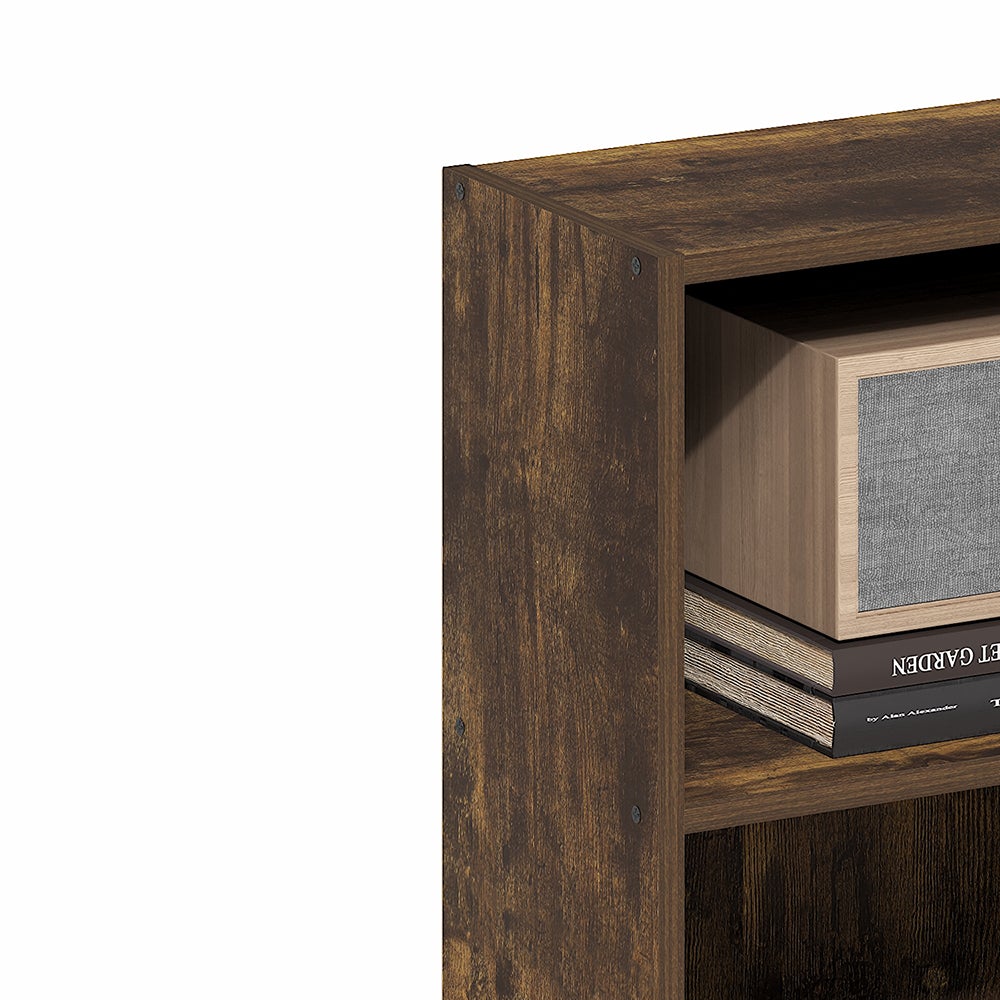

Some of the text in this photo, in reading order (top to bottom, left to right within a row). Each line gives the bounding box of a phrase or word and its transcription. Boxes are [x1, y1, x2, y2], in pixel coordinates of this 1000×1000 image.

[891, 646, 975, 677] GARDEN
[881, 711, 905, 720] Alan
[907, 704, 958, 716] Alexander
